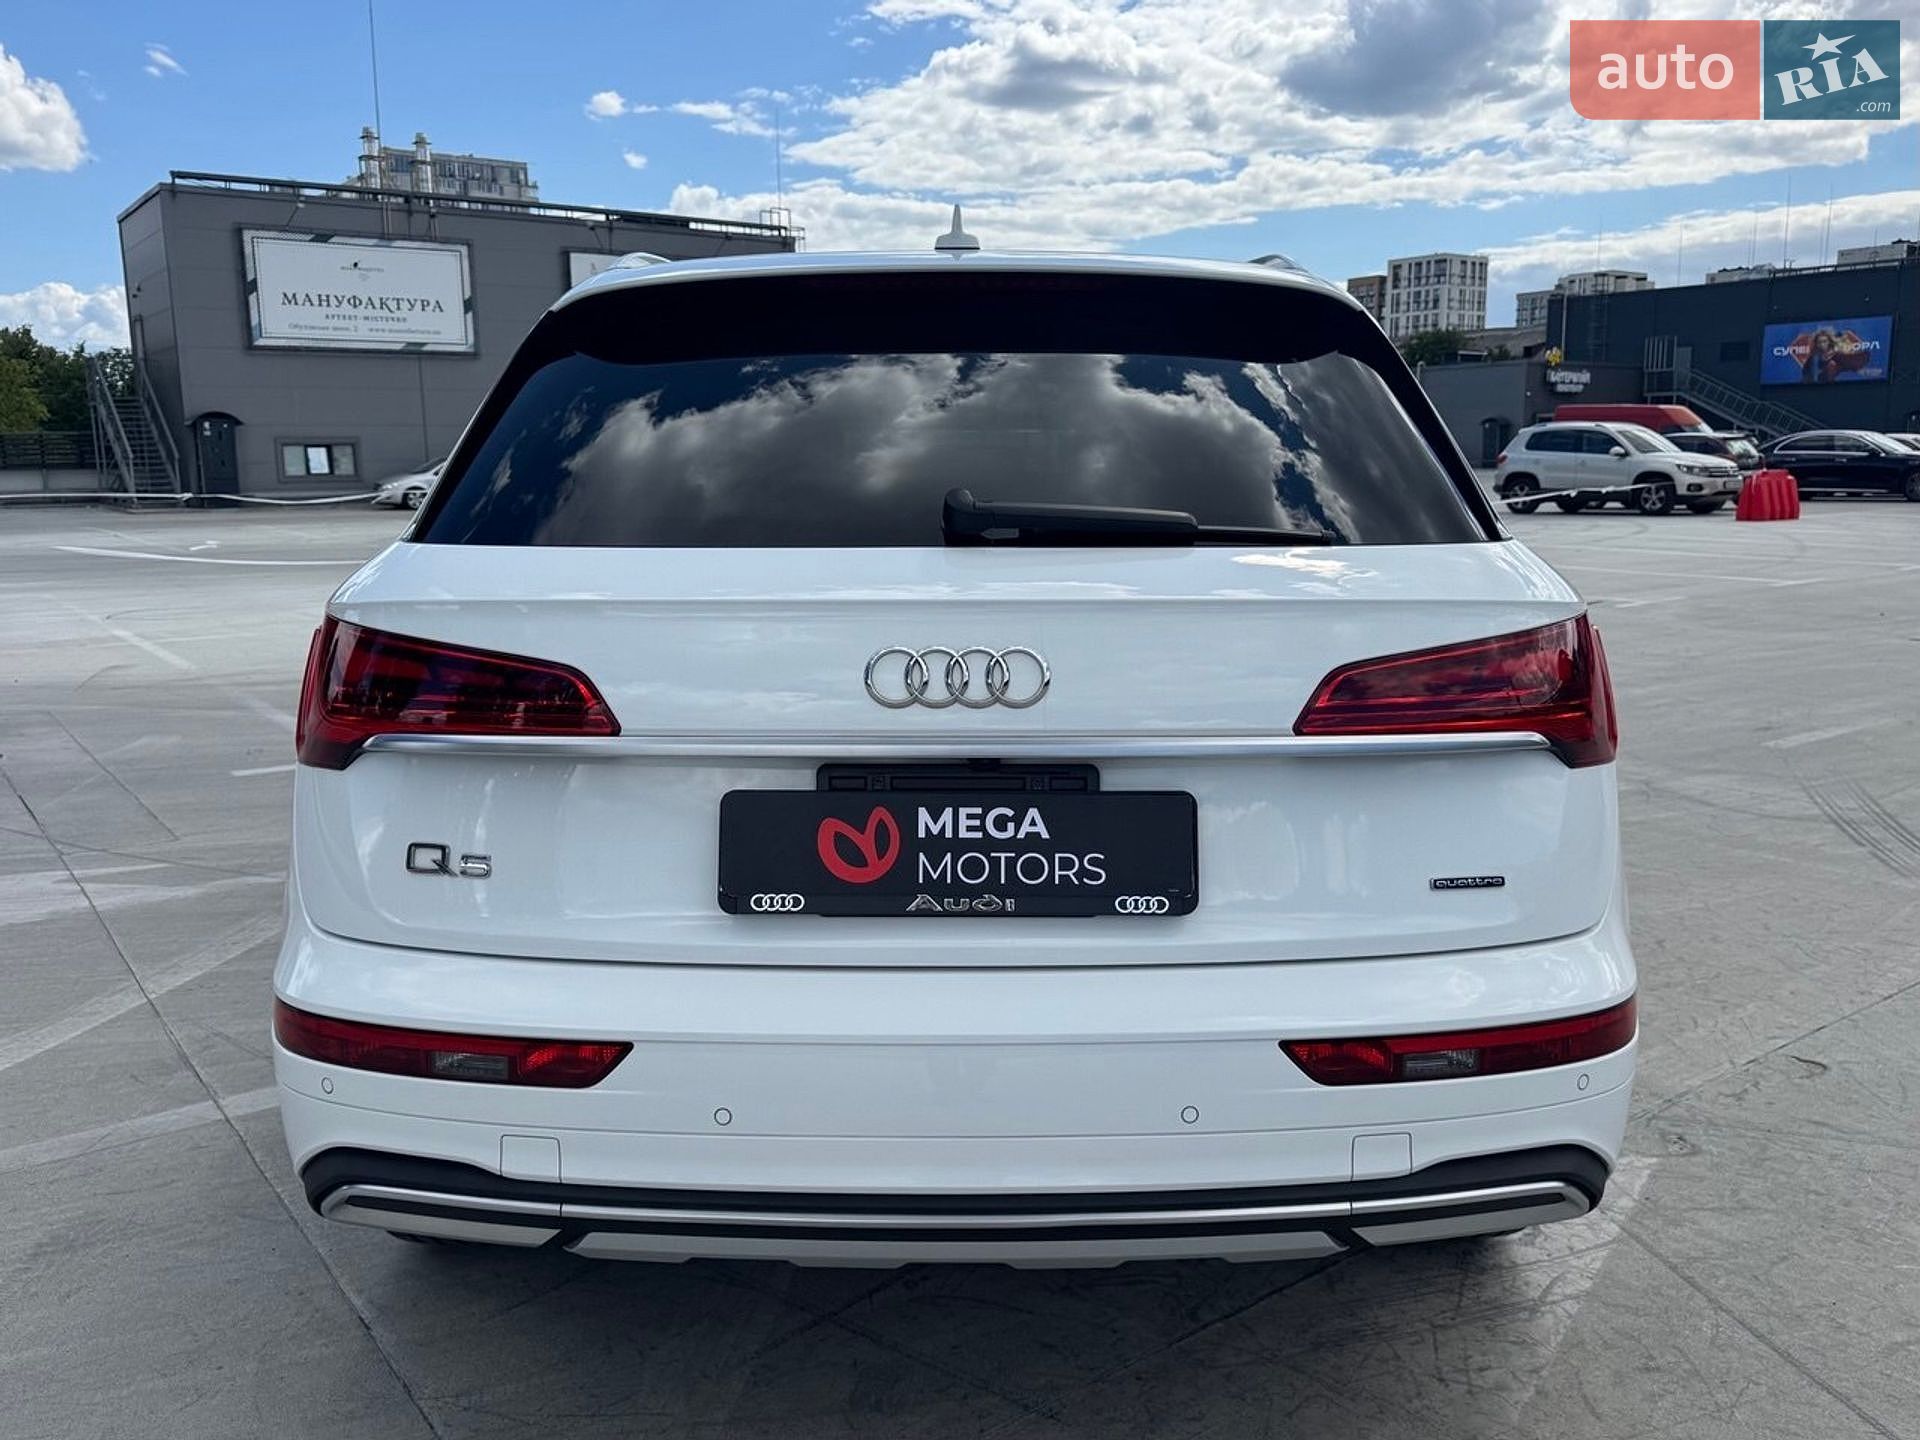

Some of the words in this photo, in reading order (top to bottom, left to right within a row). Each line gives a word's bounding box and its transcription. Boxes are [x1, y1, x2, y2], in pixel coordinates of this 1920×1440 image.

[280, 291, 445, 314] МАНУФАКТУРА
[917, 806, 1051, 840] MEGA
[406, 842, 491, 879] Q5
[917, 852, 1107, 886] MOTORS
[1435, 877, 1503, 889] quattro
[905, 894, 1015, 911] Audi
